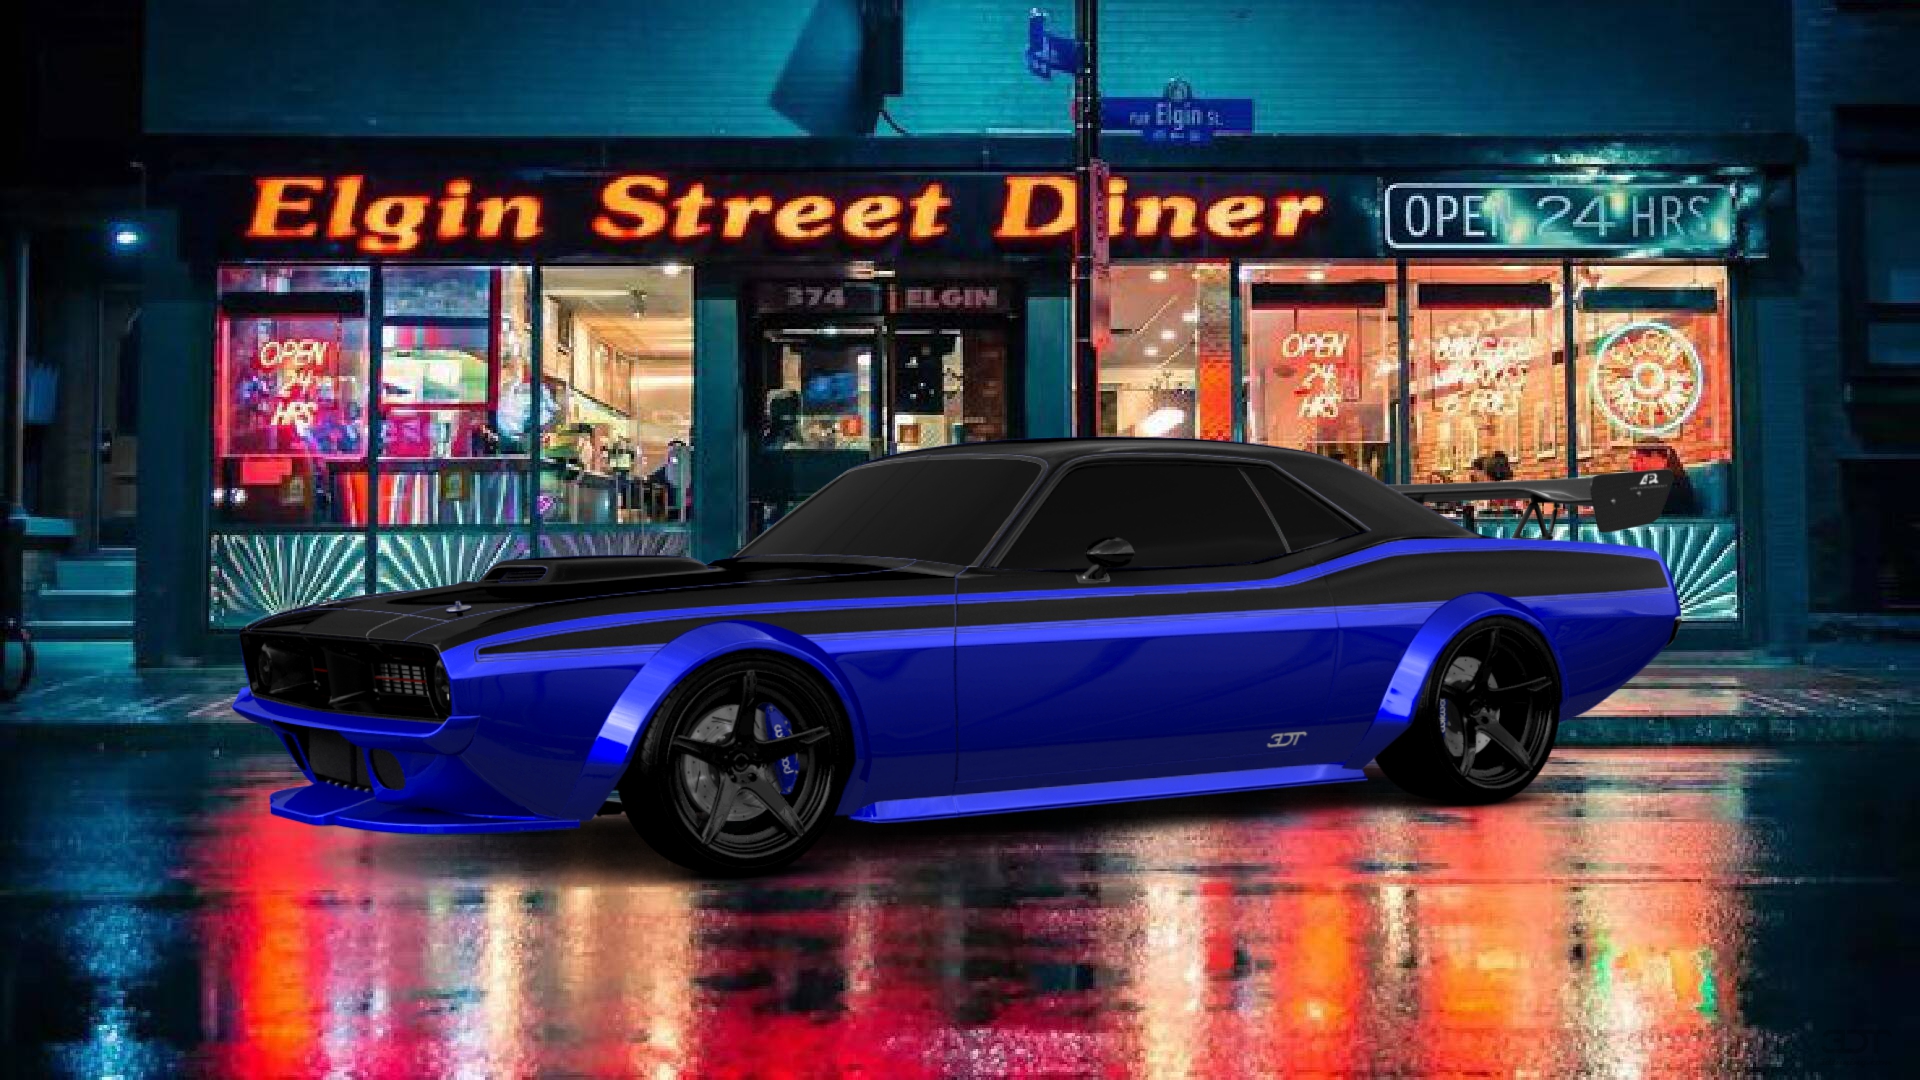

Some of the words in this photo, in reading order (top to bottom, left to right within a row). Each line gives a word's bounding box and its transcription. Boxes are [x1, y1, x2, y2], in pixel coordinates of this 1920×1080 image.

[1156, 102, 1203, 130] Elgin
[246, 174, 545, 252] Elgin
[592, 175, 951, 239] Street
[994, 175, 1325, 238] Diner
[1537, 195, 1616, 238] 24
[1632, 195, 1711, 238] HRS
[786, 287, 845, 306] 374
[907, 289, 997, 308] ELGIN
[261, 340, 329, 366] OPEN
[1281, 333, 1348, 358] OPEN
[279, 371, 313, 398] 24
[271, 401, 319, 427] HRS
